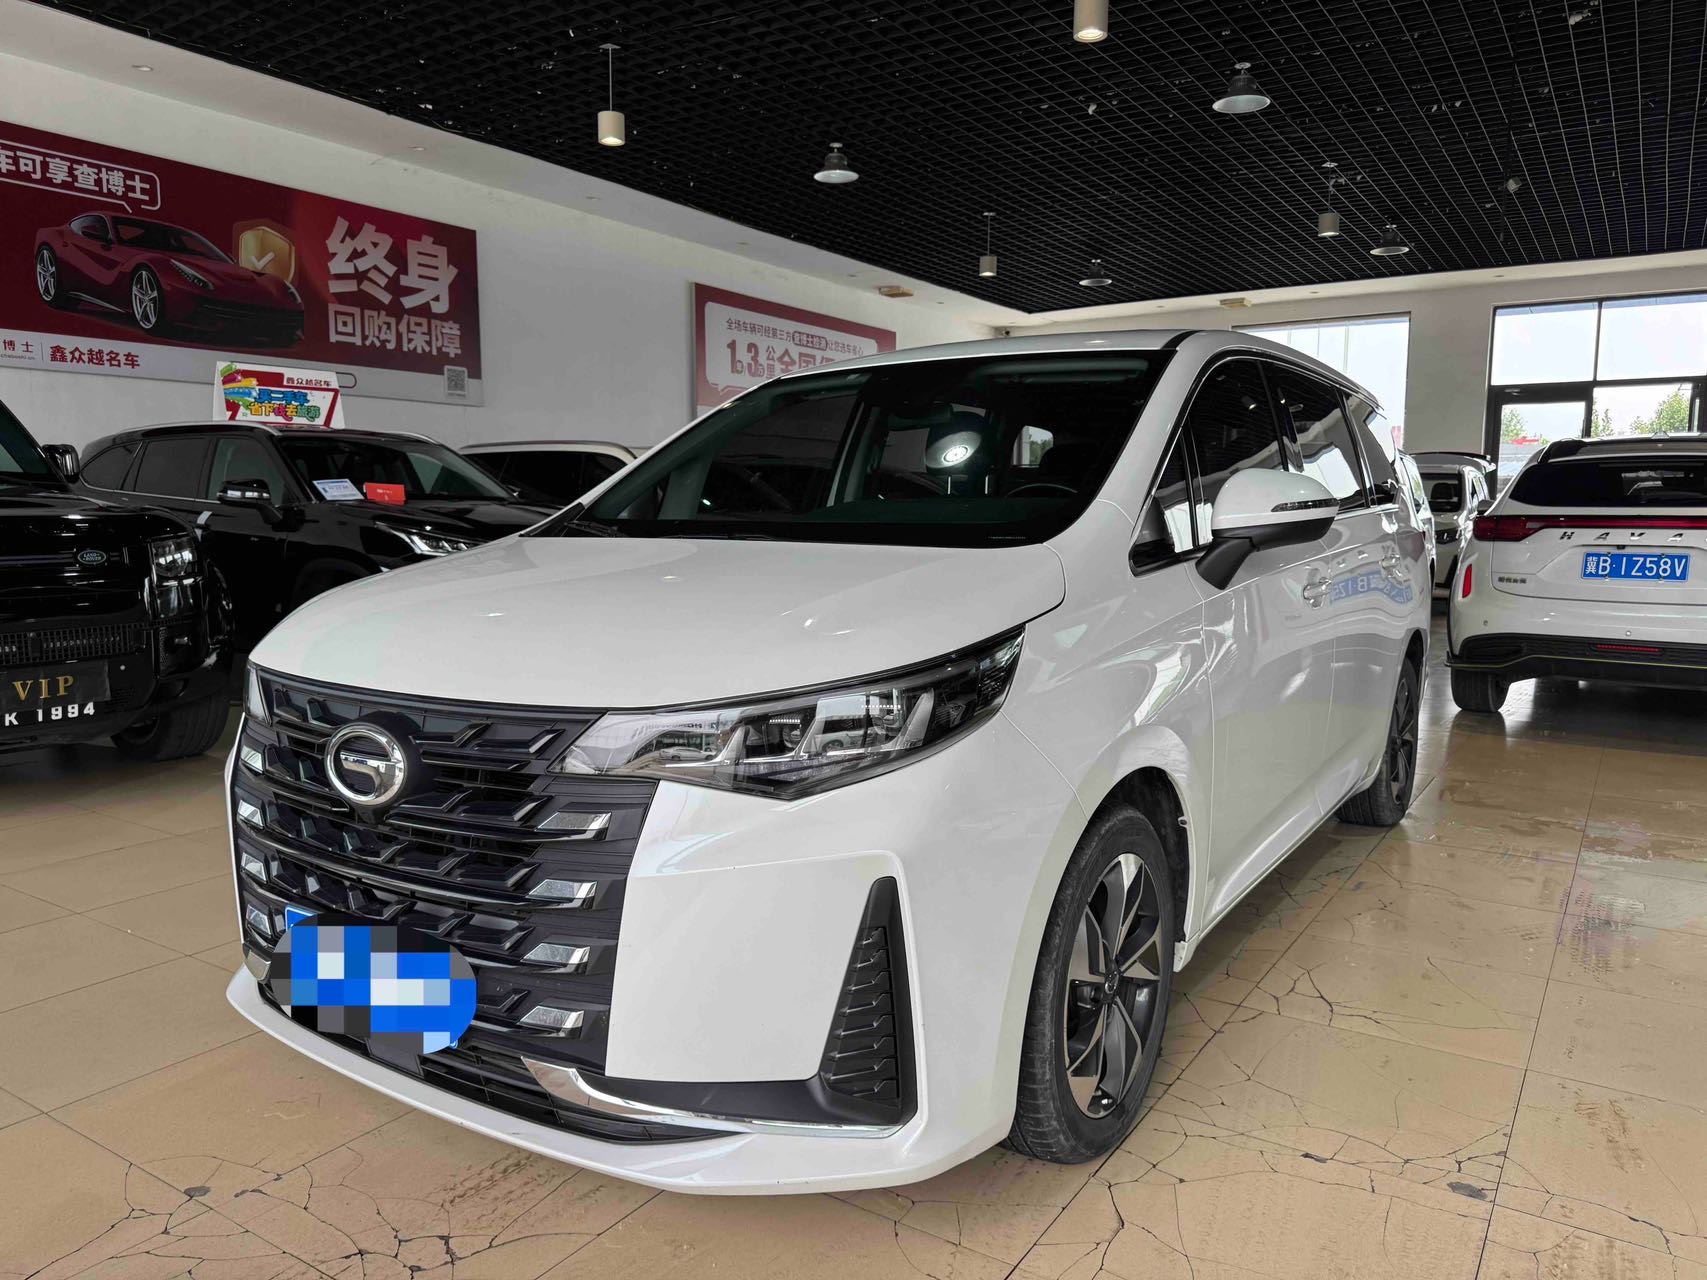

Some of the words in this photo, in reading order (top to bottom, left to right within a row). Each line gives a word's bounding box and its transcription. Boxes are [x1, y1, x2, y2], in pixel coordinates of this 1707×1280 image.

[325, 215, 459, 314] 终身
[327, 302, 462, 358] 回购保障
[2, 339, 34, 353] 博士
[49, 344, 140, 369] 鑫众越名车
[1559, 531, 1707, 542] HAVA
[12, 675, 75, 700] VIP
[4, 711, 19, 727] K
[36, 701, 96, 722] 1994
